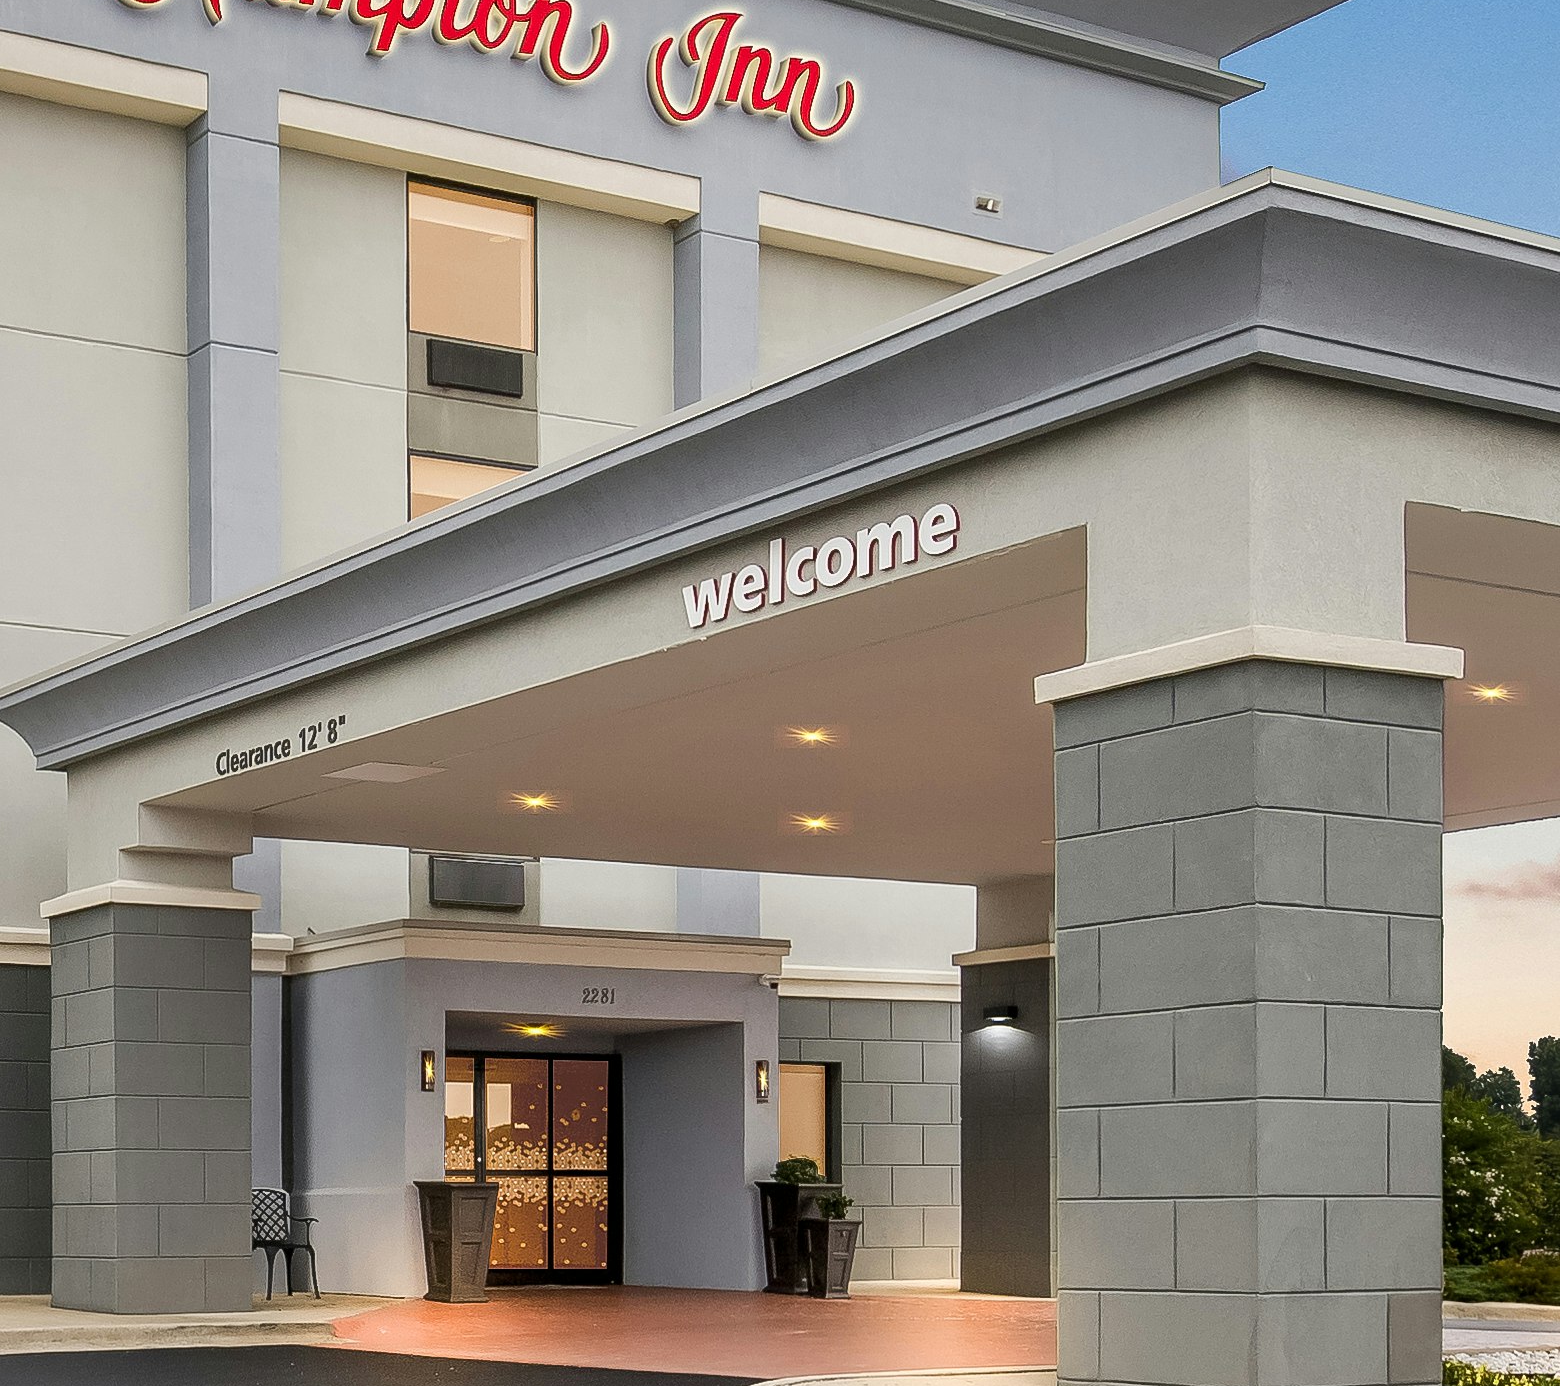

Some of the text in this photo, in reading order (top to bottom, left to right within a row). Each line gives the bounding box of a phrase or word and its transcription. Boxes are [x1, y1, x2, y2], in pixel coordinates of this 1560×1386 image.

[649, 12, 855, 139] Inn
[682, 503, 960, 628] welcome
[215, 714, 346, 776] Clearance 12' 8"
[581, 987, 616, 1004] 2281
